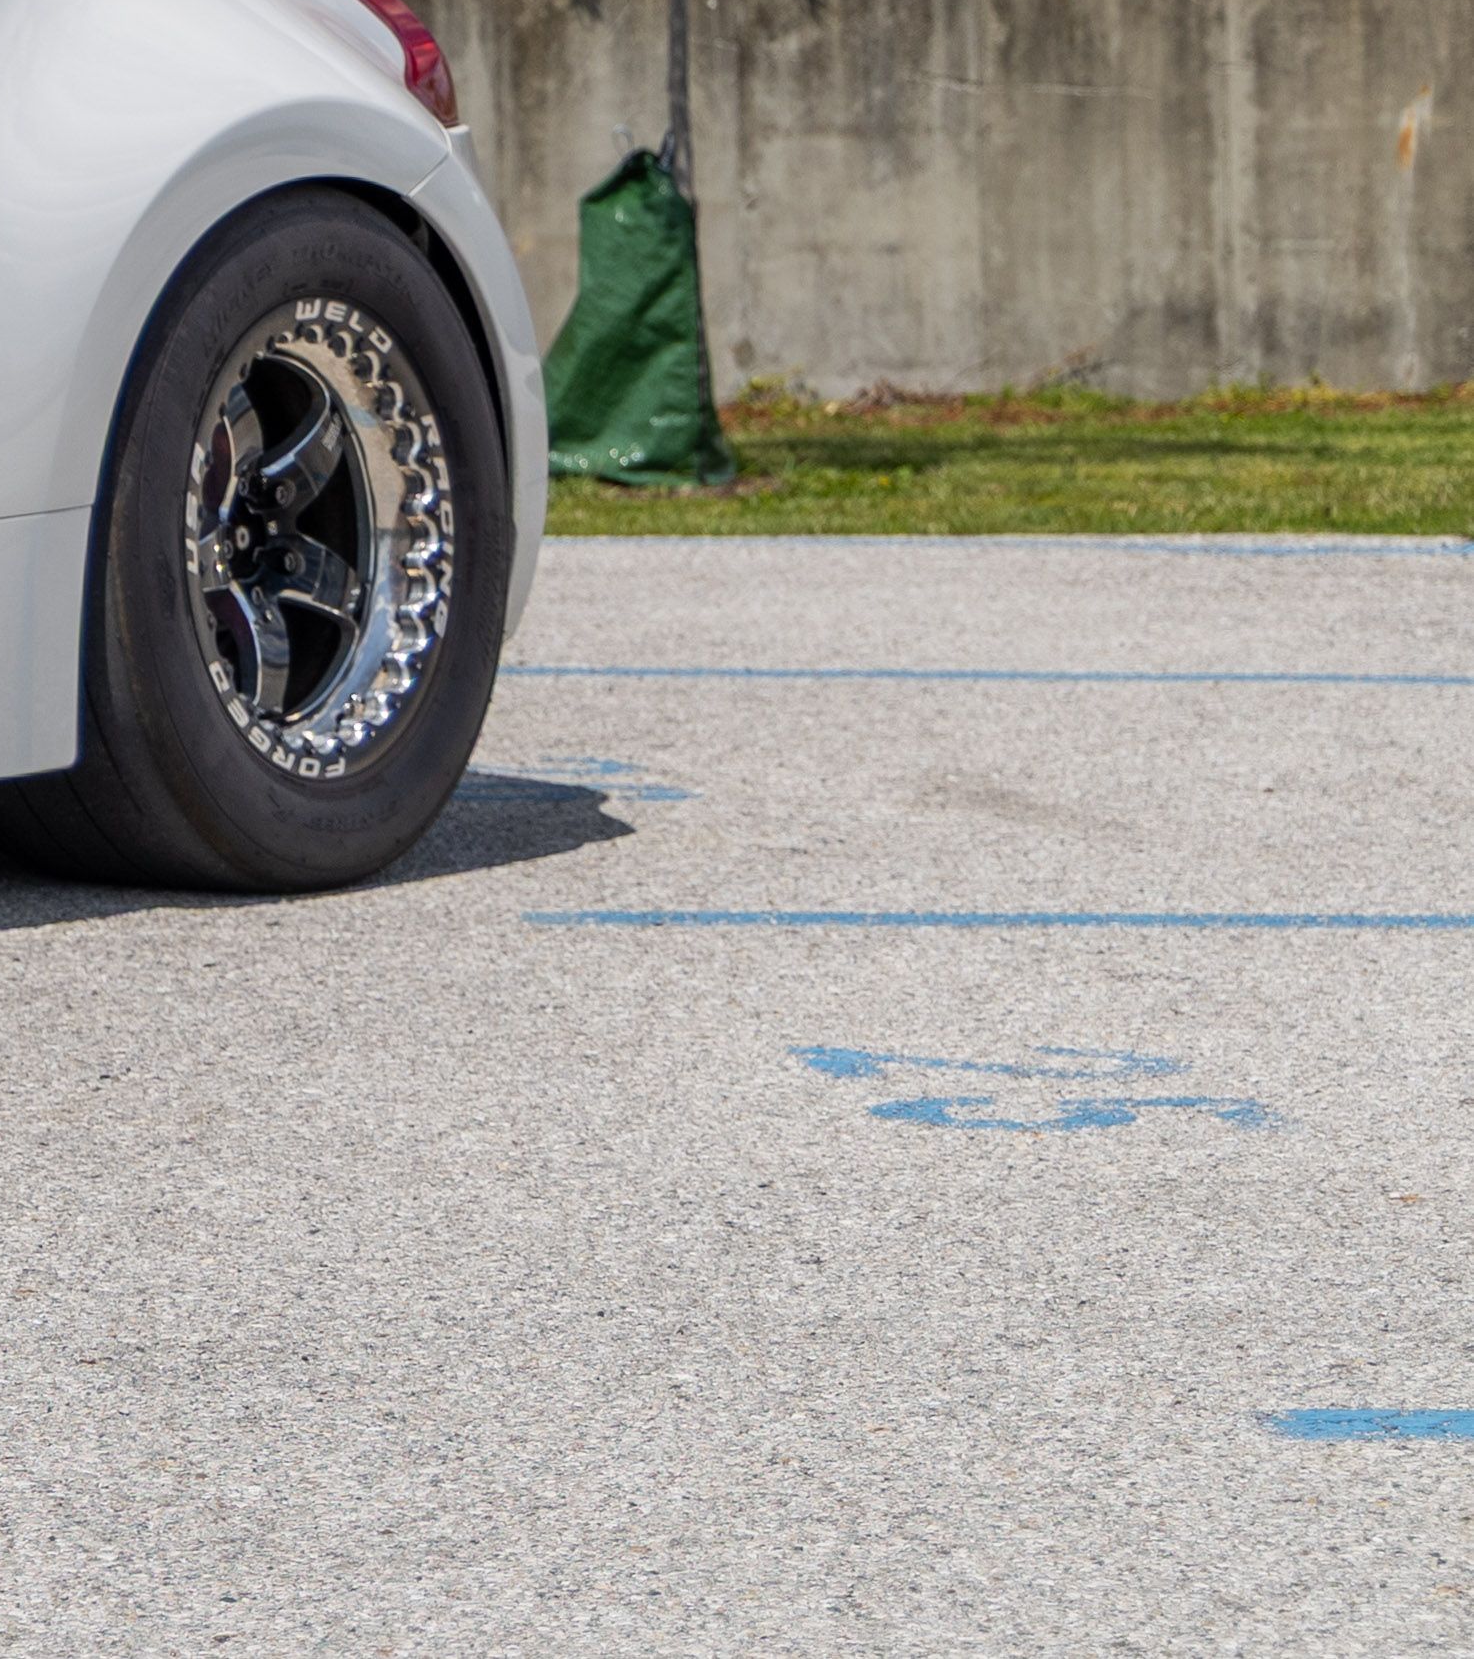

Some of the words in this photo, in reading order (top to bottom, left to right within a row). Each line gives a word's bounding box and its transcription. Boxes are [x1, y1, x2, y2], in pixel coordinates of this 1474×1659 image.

[295, 298, 393, 354] WELD
[185, 442, 205, 576] USA
[209, 661, 345, 780] FORGED
